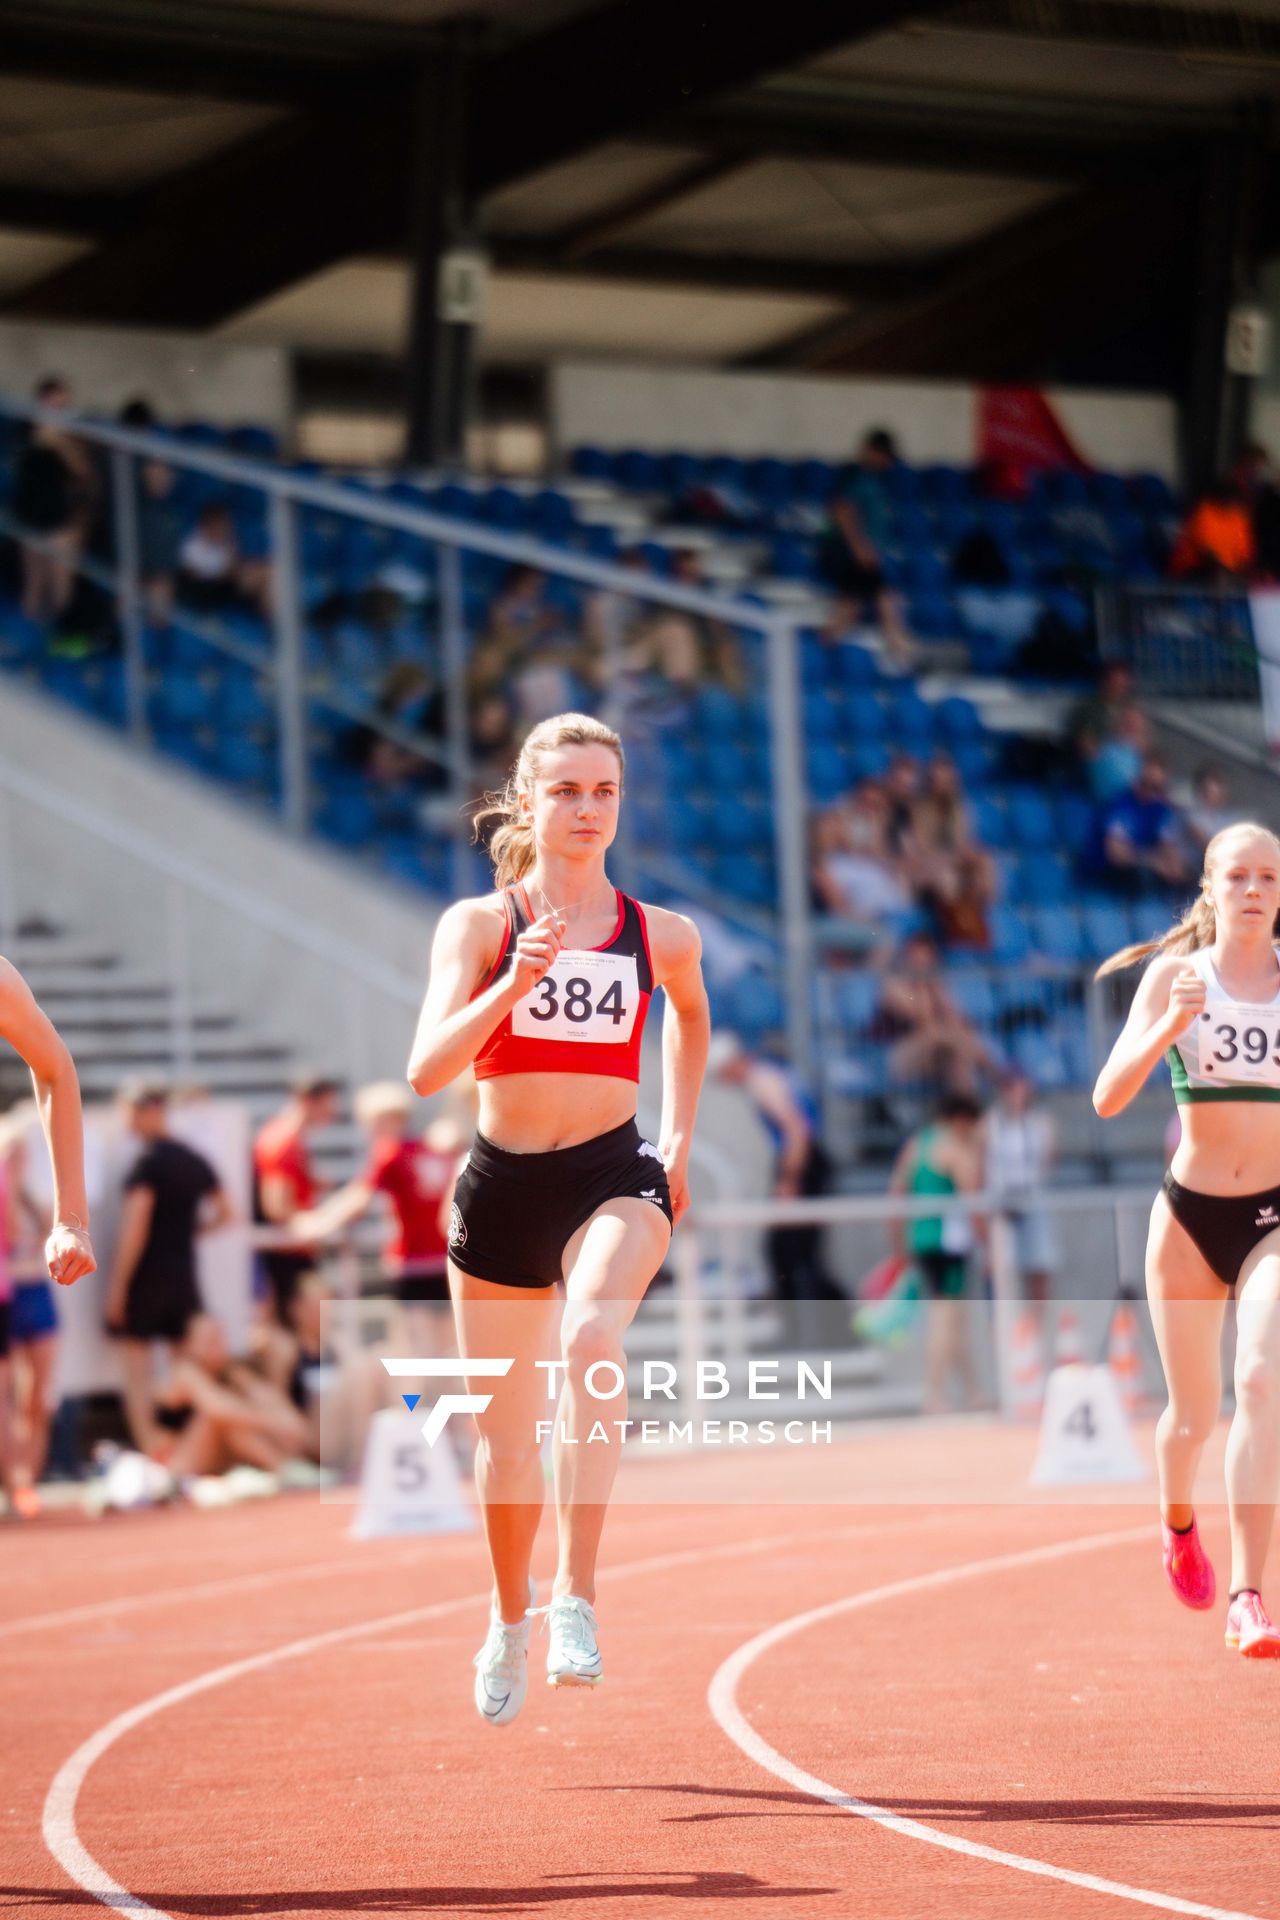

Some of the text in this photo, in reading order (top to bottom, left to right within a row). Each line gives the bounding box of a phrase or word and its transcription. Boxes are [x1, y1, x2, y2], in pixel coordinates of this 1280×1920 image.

[529, 975, 627, 1025] 384
[1063, 1400, 1098, 1441] 4
[394, 1444, 429, 1494] 5
